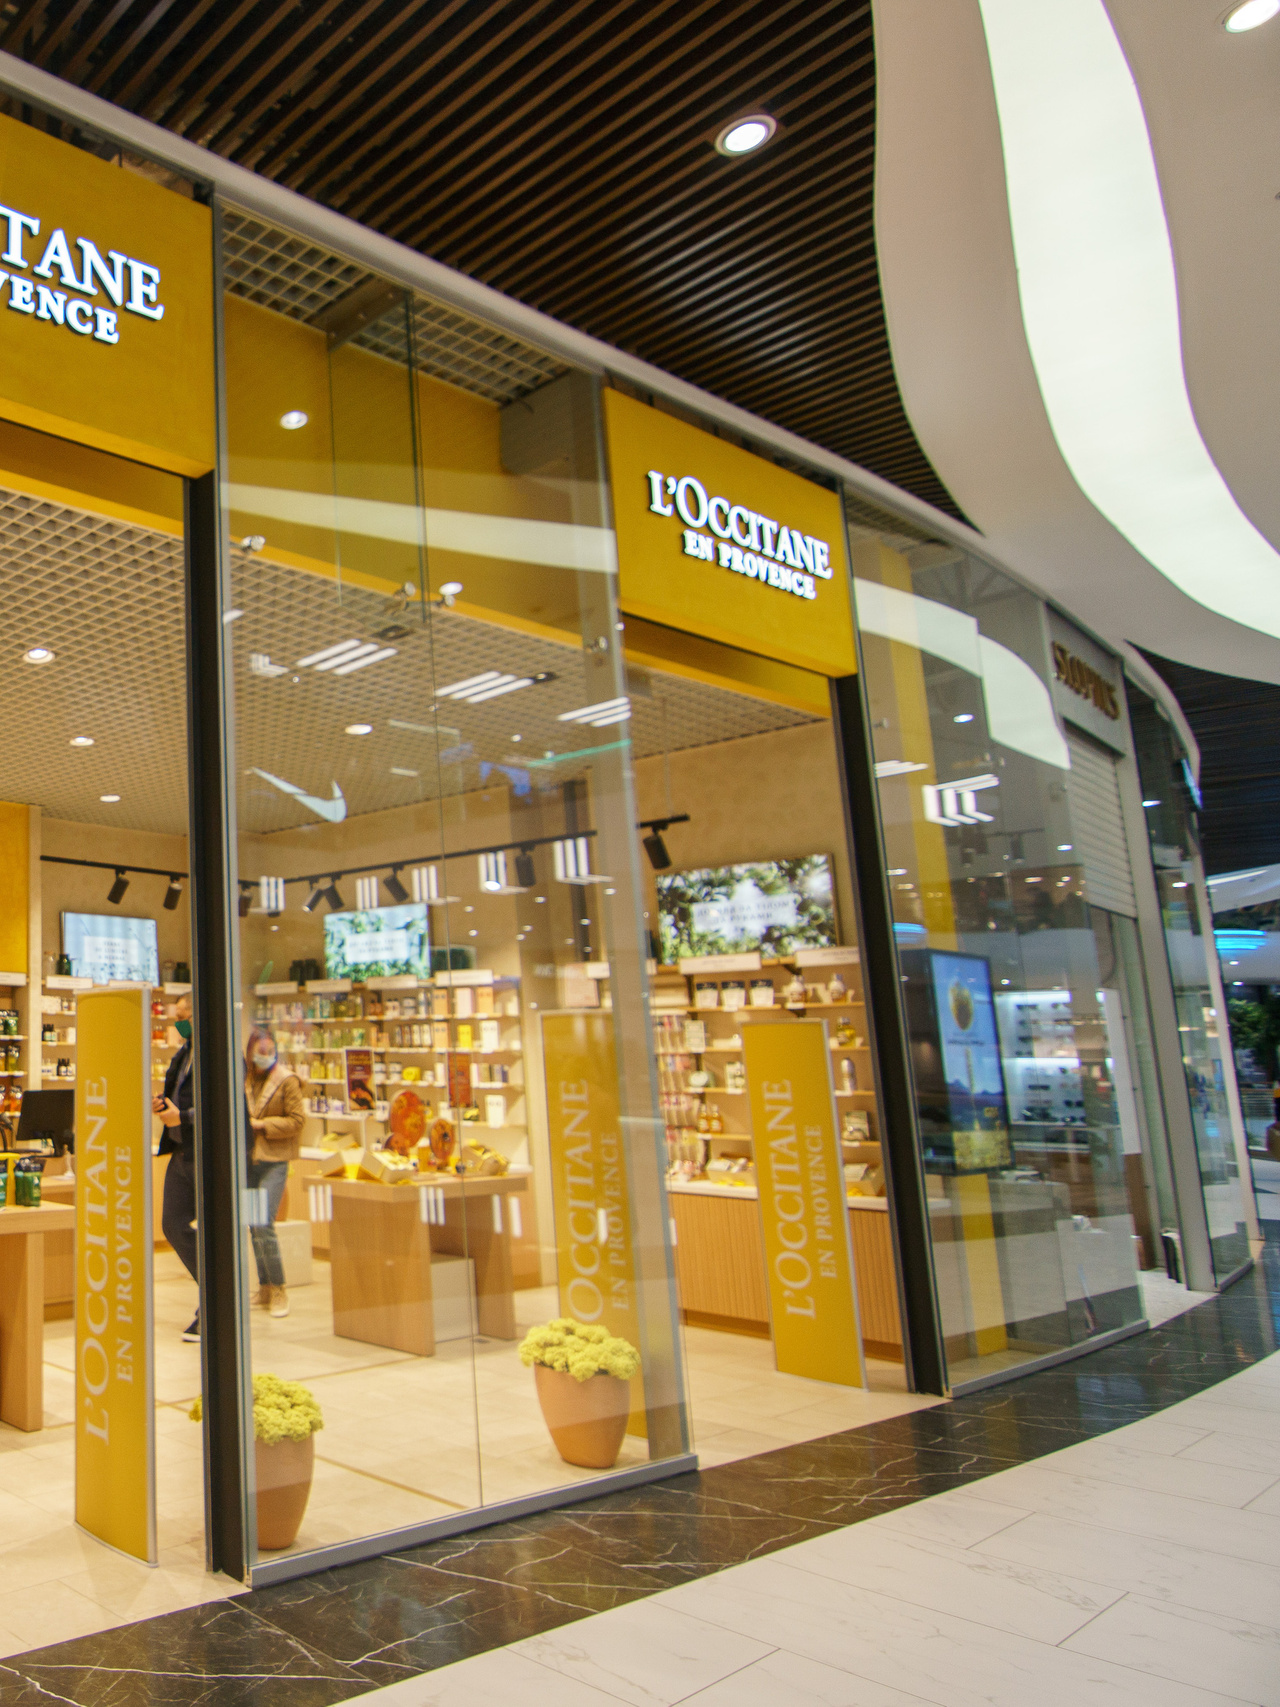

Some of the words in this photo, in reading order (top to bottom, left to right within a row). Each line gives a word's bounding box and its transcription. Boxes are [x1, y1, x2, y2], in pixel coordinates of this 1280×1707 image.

[648, 470, 833, 579] L'OCCITANE
[683, 529, 714, 561] EN
[718, 542, 816, 600] PROVENCE
[115, 1145, 134, 1324] PROVENCE
[560, 1078, 604, 1323] OCCITANE
[601, 1131, 627, 1267] PROVENCE
[805, 1124, 834, 1242] PROVENCE
[611, 1276, 630, 1311] EN
[820, 1248, 838, 1279] EN
[116, 1337, 134, 1383] EN
